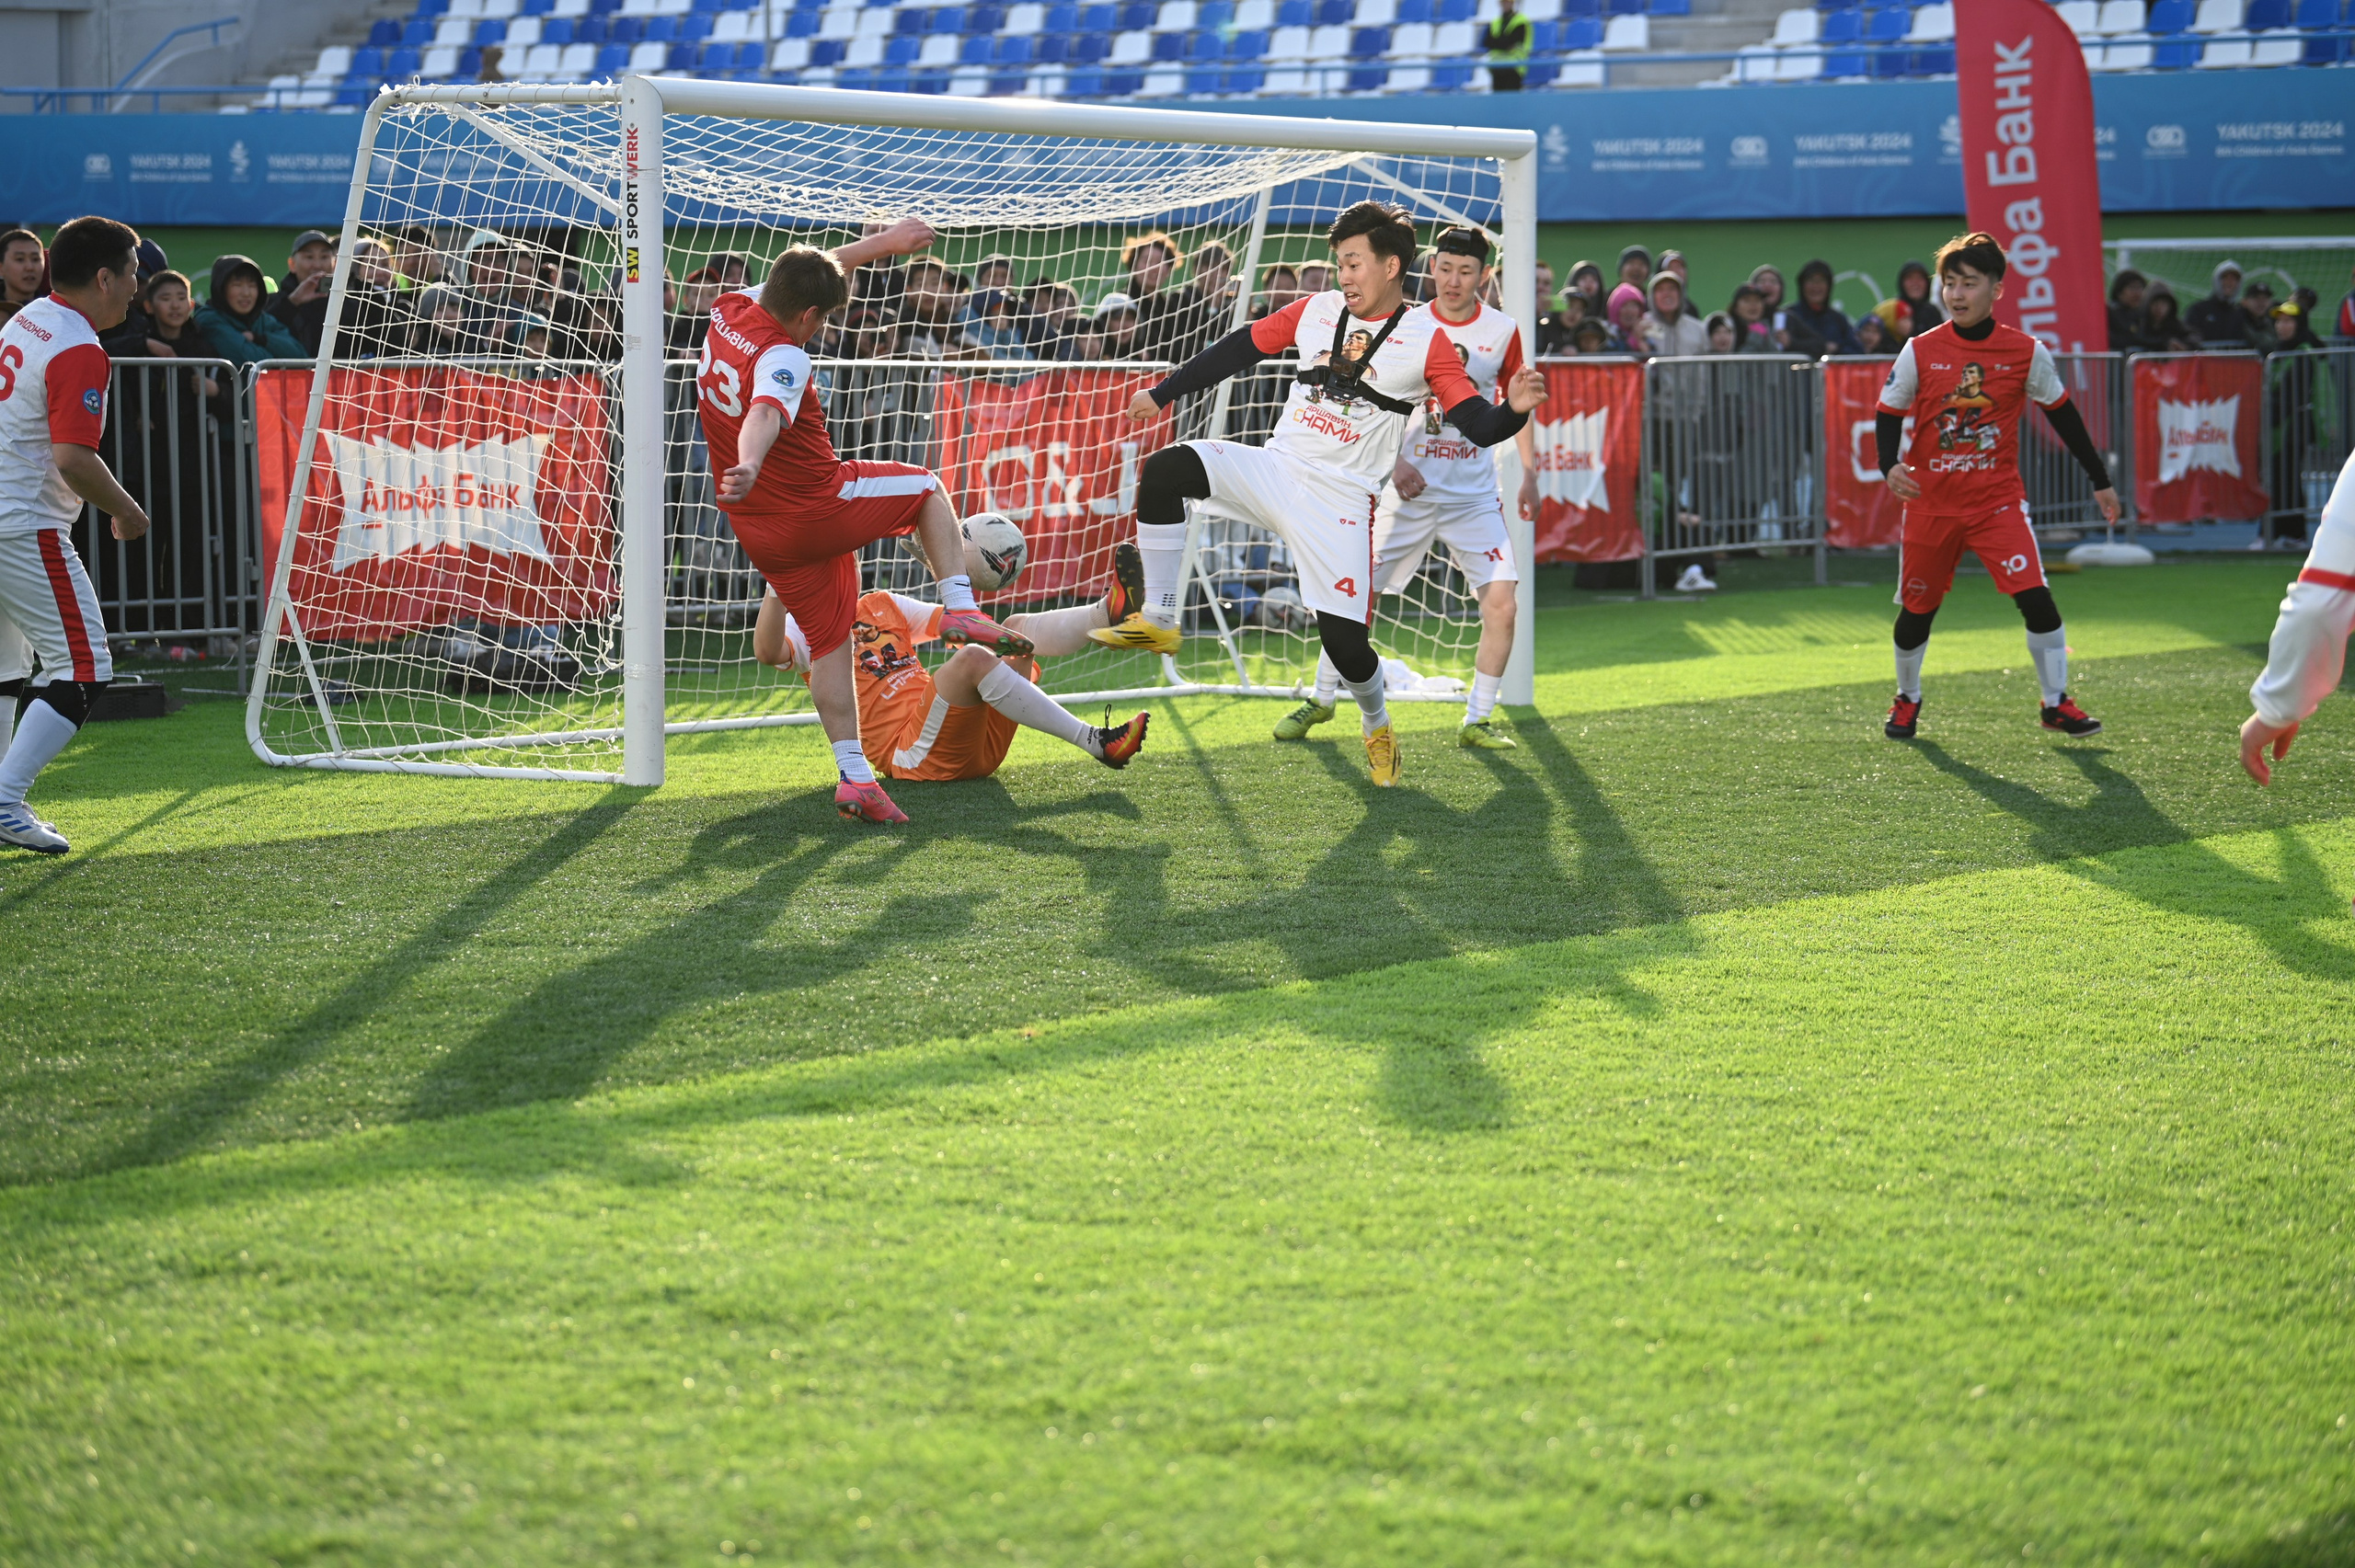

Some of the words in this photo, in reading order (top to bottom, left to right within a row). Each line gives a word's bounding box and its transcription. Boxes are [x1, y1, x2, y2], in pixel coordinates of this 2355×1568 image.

[1985, 35, 2038, 187] Банк
[1591, 138, 1660, 156] YAKUTSK
[1662, 137, 1705, 155] 2024
[1795, 133, 1866, 152] YAKUTSK
[1869, 132, 1912, 150] 2024
[2095, 126, 2116, 144] 24
[2216, 121, 2296, 141] YAKUTSK
[2298, 120, 2344, 139] 2024
[626, 127, 638, 239] SPORTWERK
[626, 248, 638, 281] SW
[2004, 196, 2062, 357] льфа
[709, 307, 760, 358] АРШАВИН
[0, 338, 23, 402] 6
[696, 336, 742, 418] 23
[1306, 405, 1351, 429] АРШАВИН
[362, 475, 446, 519] Альфа
[453, 474, 521, 509] Банк
[2001, 554, 2028, 576] 10
[1334, 577, 1357, 598] 4
